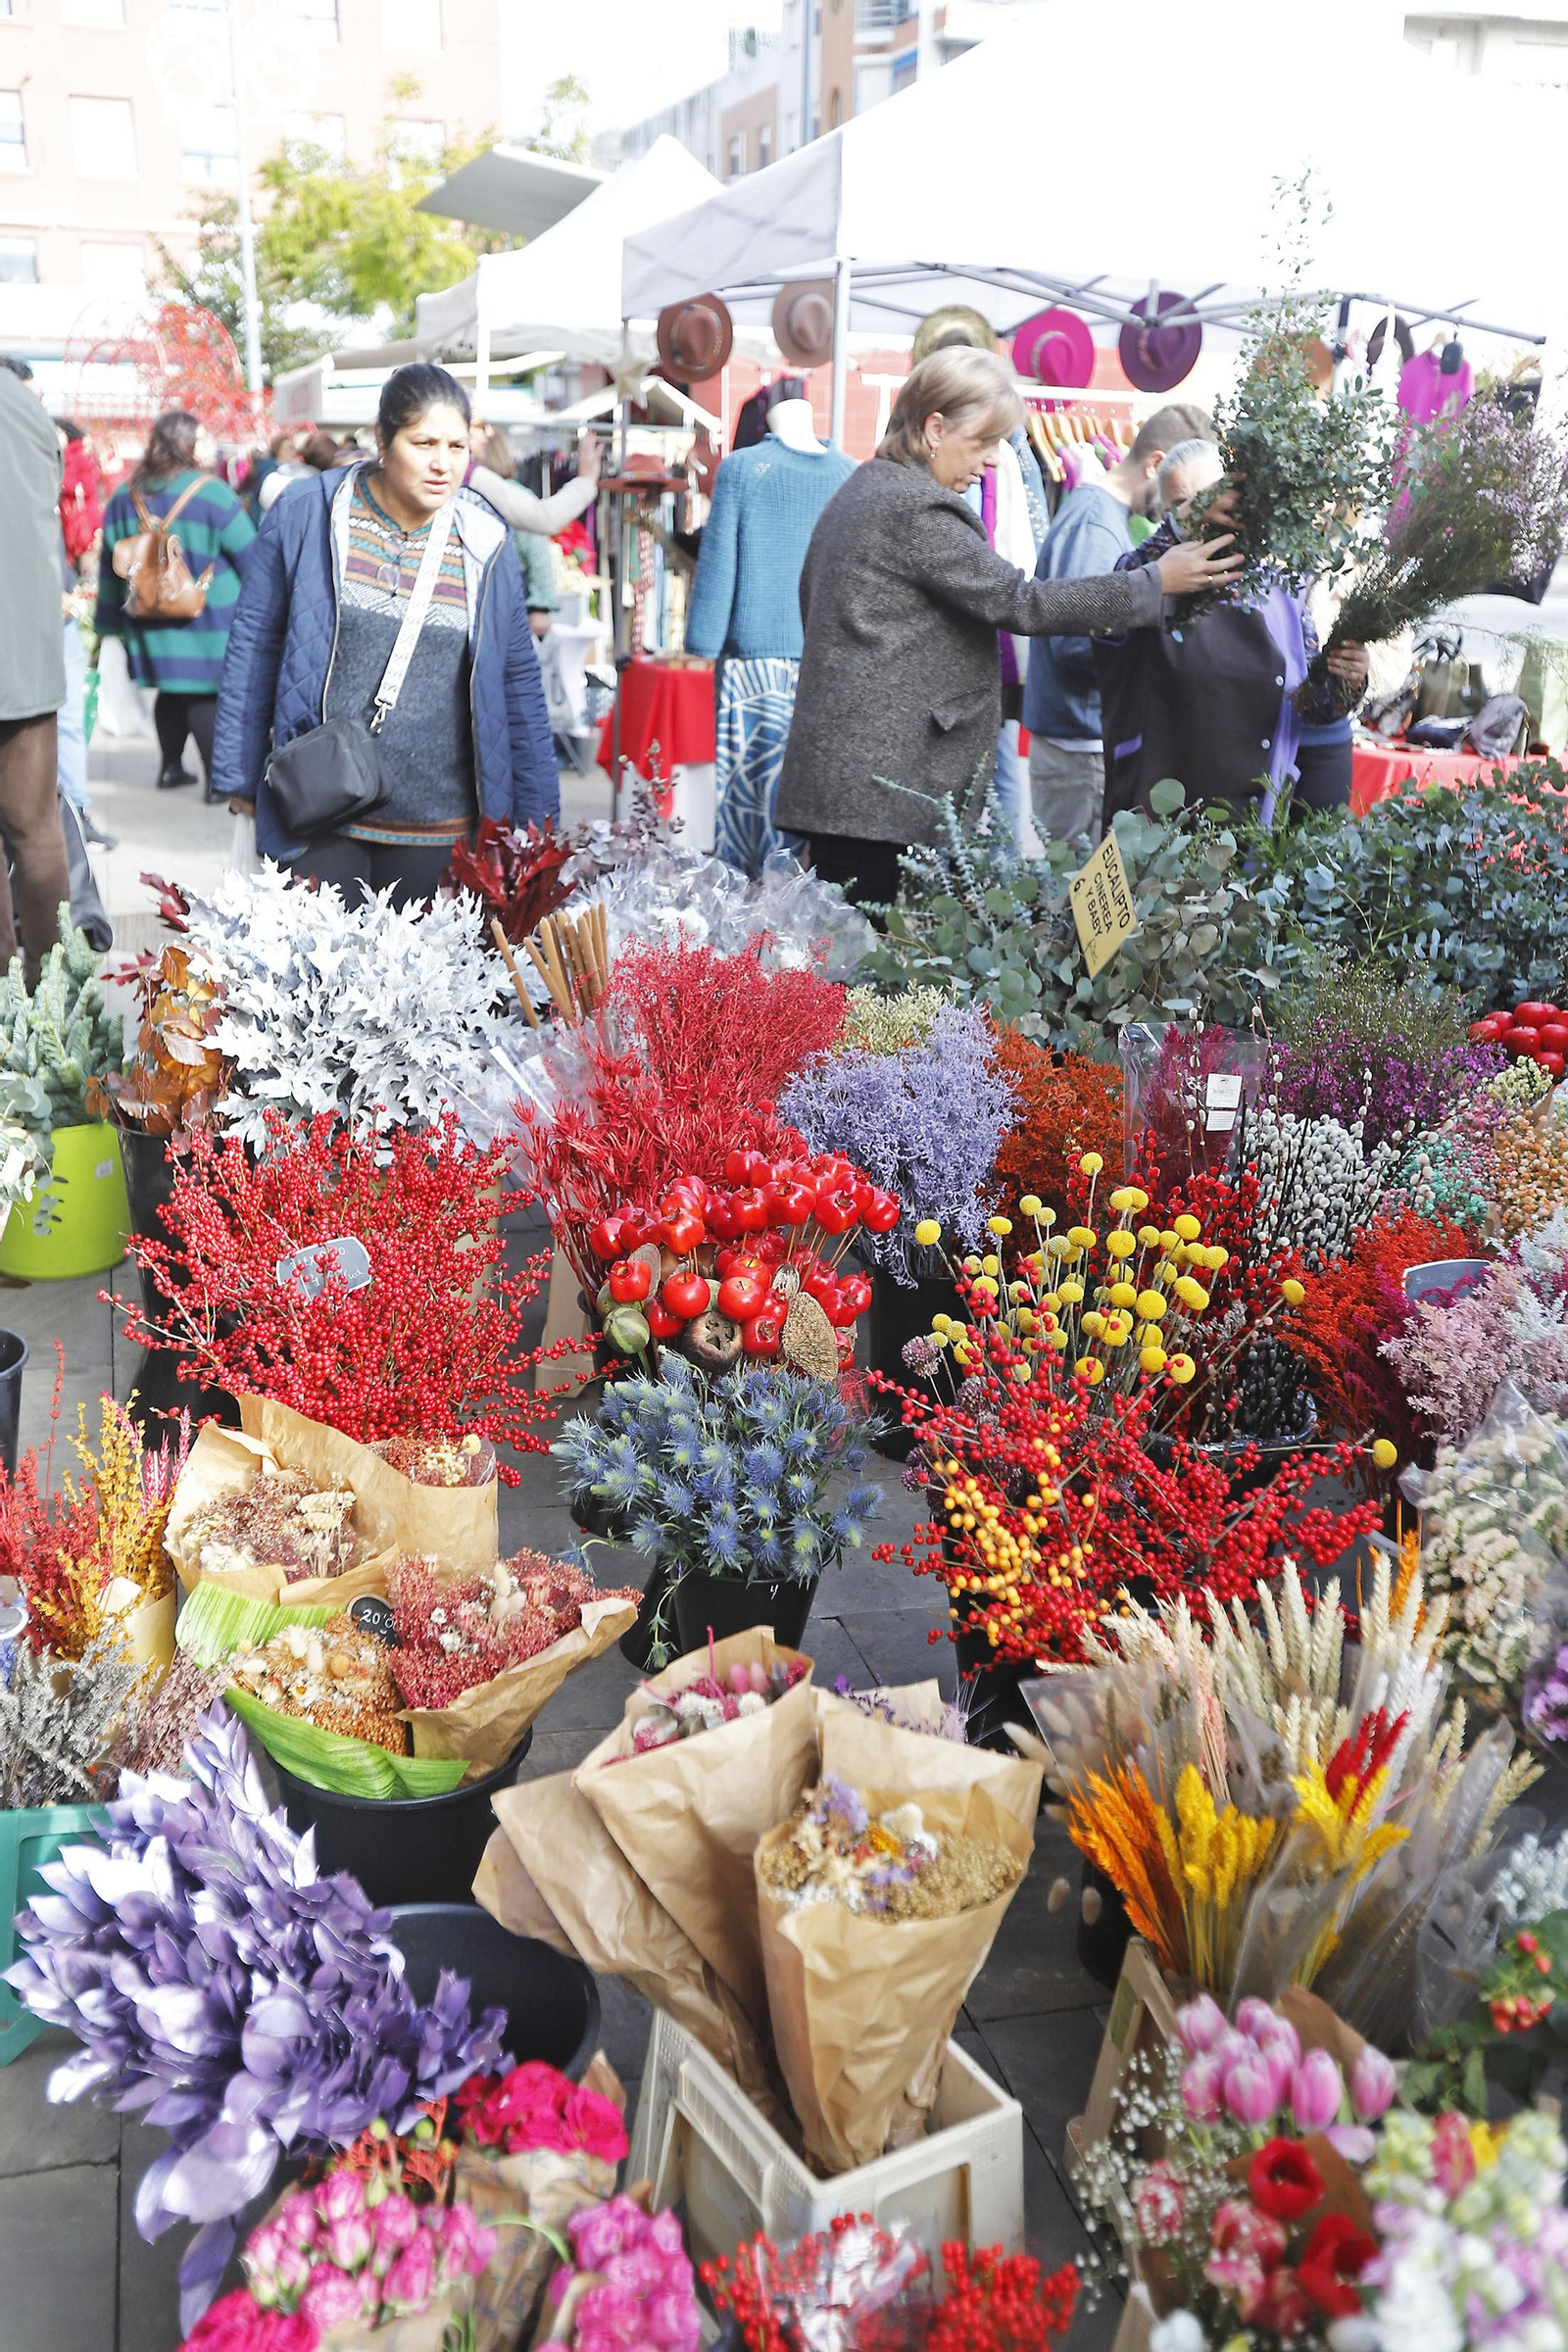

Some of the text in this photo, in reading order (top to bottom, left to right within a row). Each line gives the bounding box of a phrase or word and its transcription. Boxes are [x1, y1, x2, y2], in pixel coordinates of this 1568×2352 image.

[1085, 886, 1094, 899] Y
[1094, 872, 1113, 934] CINEREA
[1102, 843, 1131, 929] EUCALIPTO
[1087, 900, 1103, 938] BABY
